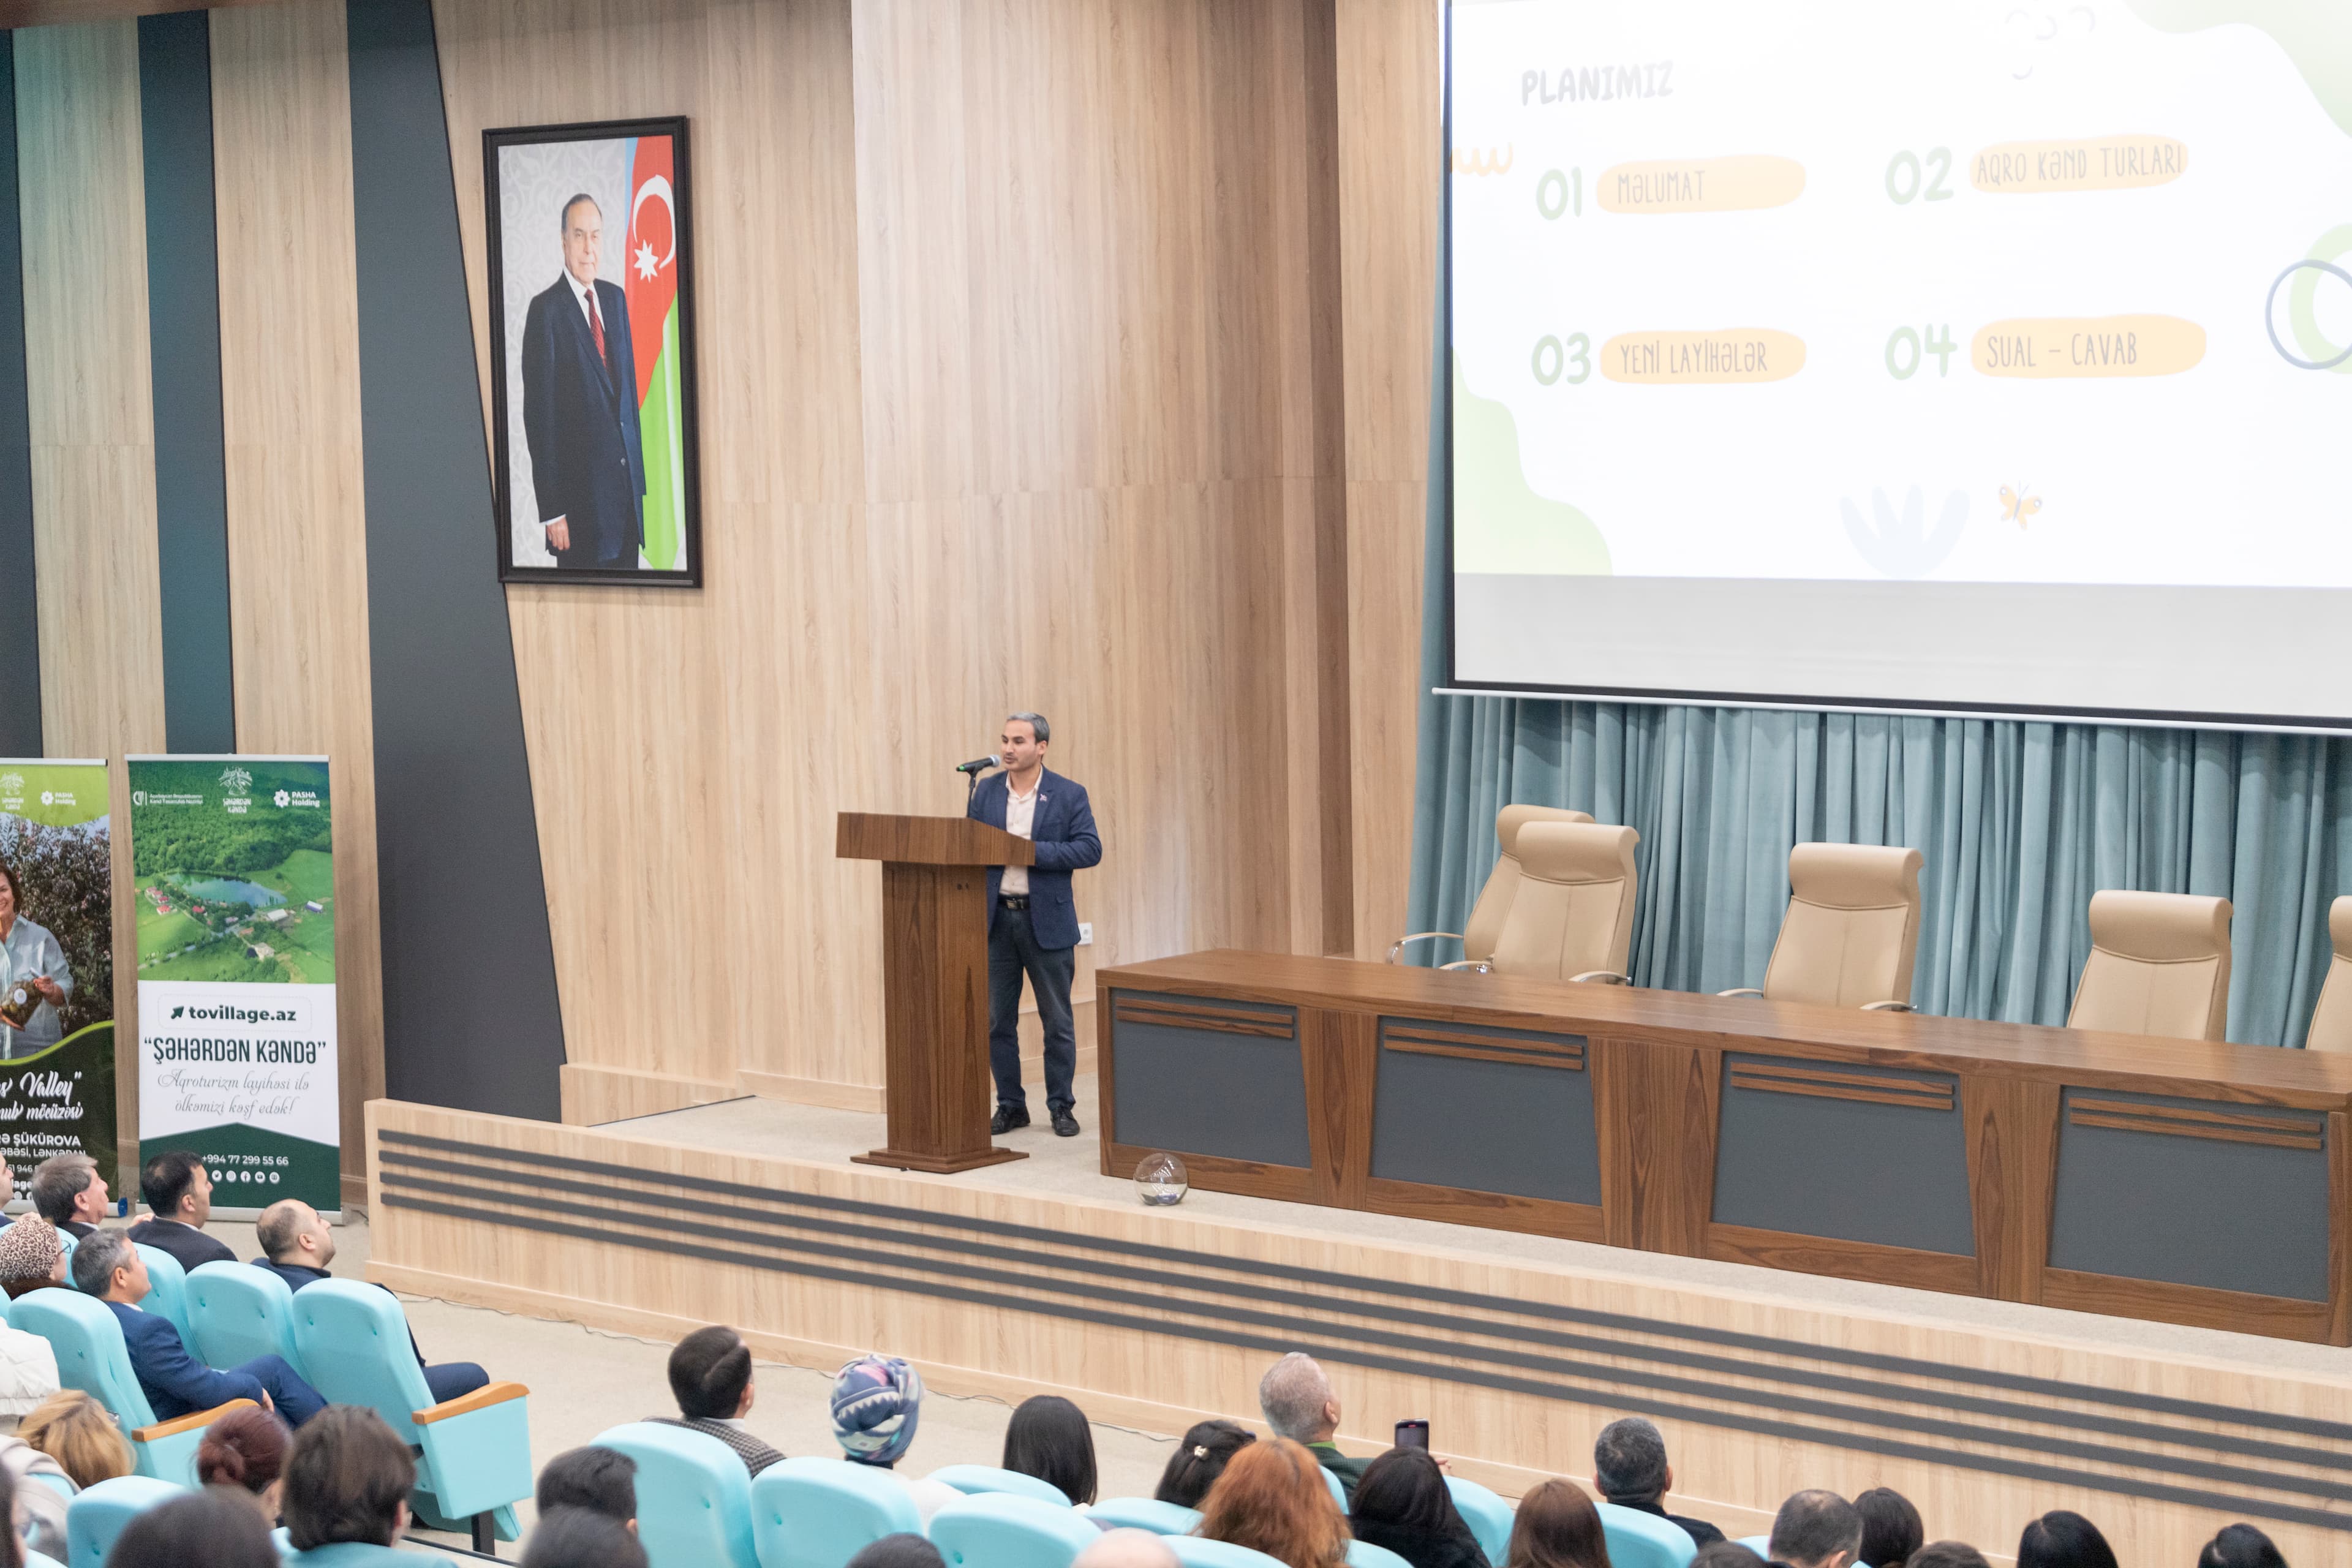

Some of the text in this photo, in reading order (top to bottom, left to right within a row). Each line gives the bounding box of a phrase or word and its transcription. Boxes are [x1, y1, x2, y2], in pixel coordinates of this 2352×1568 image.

[1521, 60, 1674, 107] PLANIMIZ
[1885, 146, 1954, 205] 02
[1977, 143, 2182, 186] AQRO KƏND TURLARI
[1536, 166, 1583, 221] 01
[1618, 170, 1705, 205] MƏLUMAT
[1531, 332, 1591, 386] 03
[1620, 339, 1768, 374] YENİ LAYİHƏLƏR
[1885, 323, 1958, 380] 04
[1987, 335, 2036, 368] SUAL
[2071, 331, 2138, 366] CAVAB
[292, 799, 320, 808] Holding
[189, 1004, 297, 1023] tovillage.az
[243, 1070, 290, 1095] layihəsi
[295, 1071, 310, 1090] ilə
[0, 1100, 24, 1120] nub
[0, 1146, 31, 1158] ƏBƏSİ,
[13, 1131, 81, 1147] ŞÜKÜROVA
[17, 1164, 33, 1173] 946
[202, 1154, 289, 1166] +994 77 299 55 66
